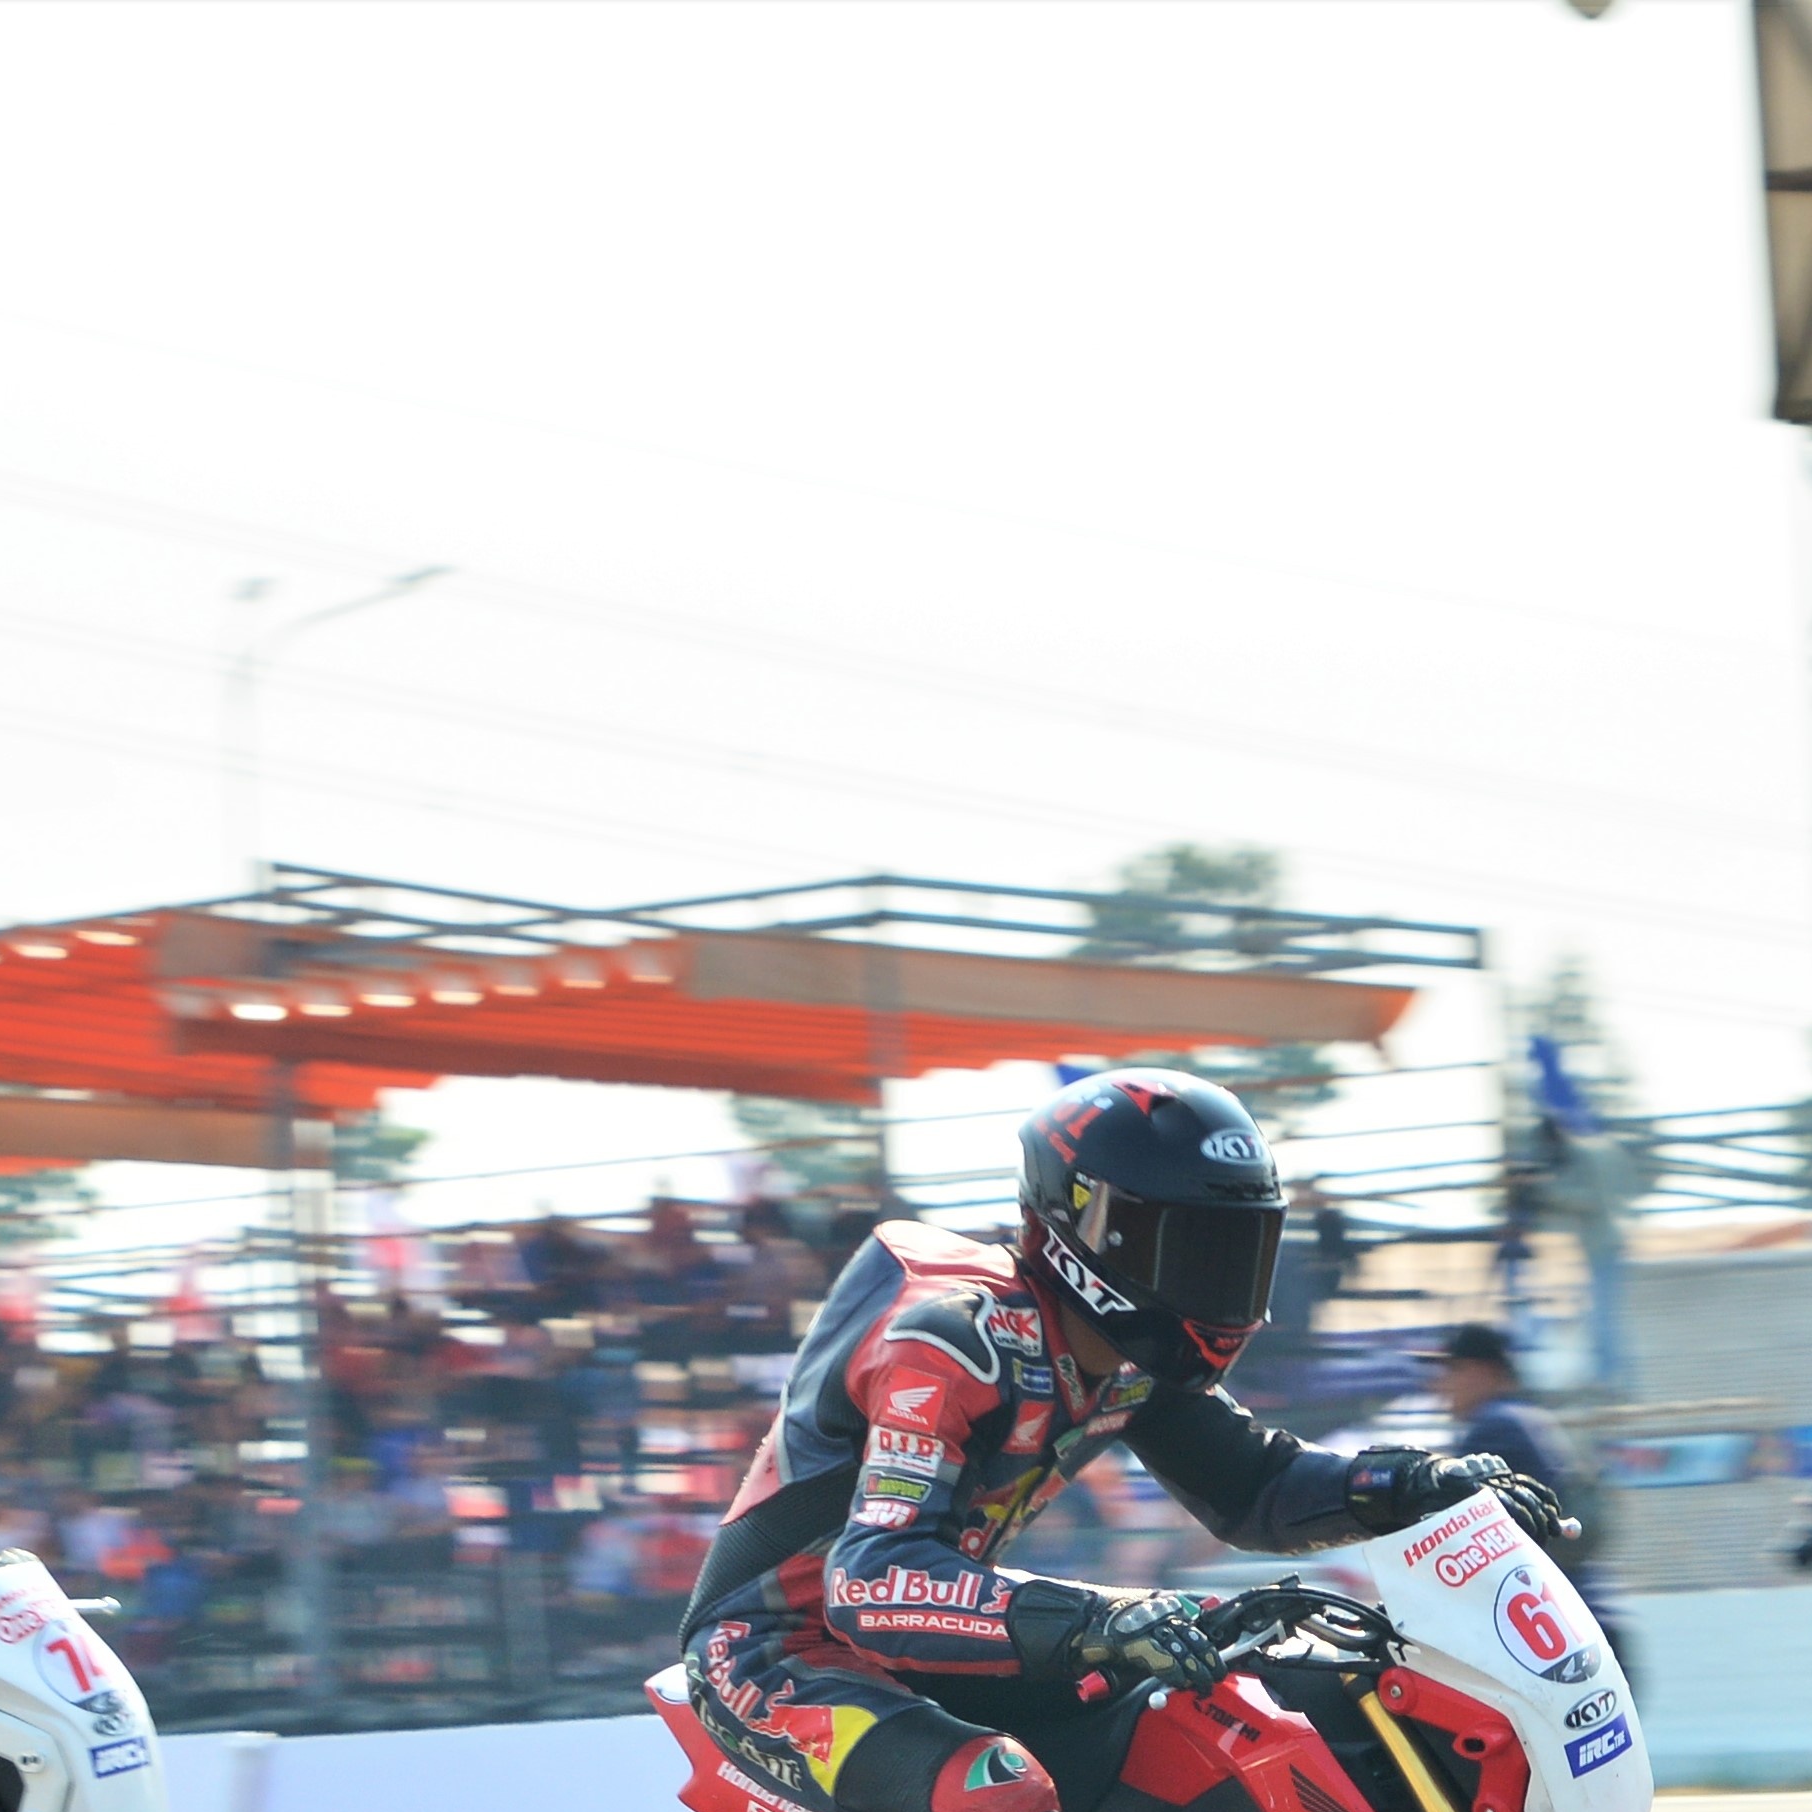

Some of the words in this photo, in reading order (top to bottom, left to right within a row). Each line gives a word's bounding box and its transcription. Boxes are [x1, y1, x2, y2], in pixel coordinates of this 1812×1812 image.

[1043, 1226, 1137, 1315] KYT
[988, 1309, 1038, 1340] NGK
[1403, 1514, 1470, 1567] Honda
[1468, 1500, 1498, 1522] Rac
[831, 1566, 896, 1607] Red
[902, 1570, 983, 1609] Bull
[860, 1615, 1008, 1637] BARRACUDA
[705, 1657, 763, 1722] Bull
